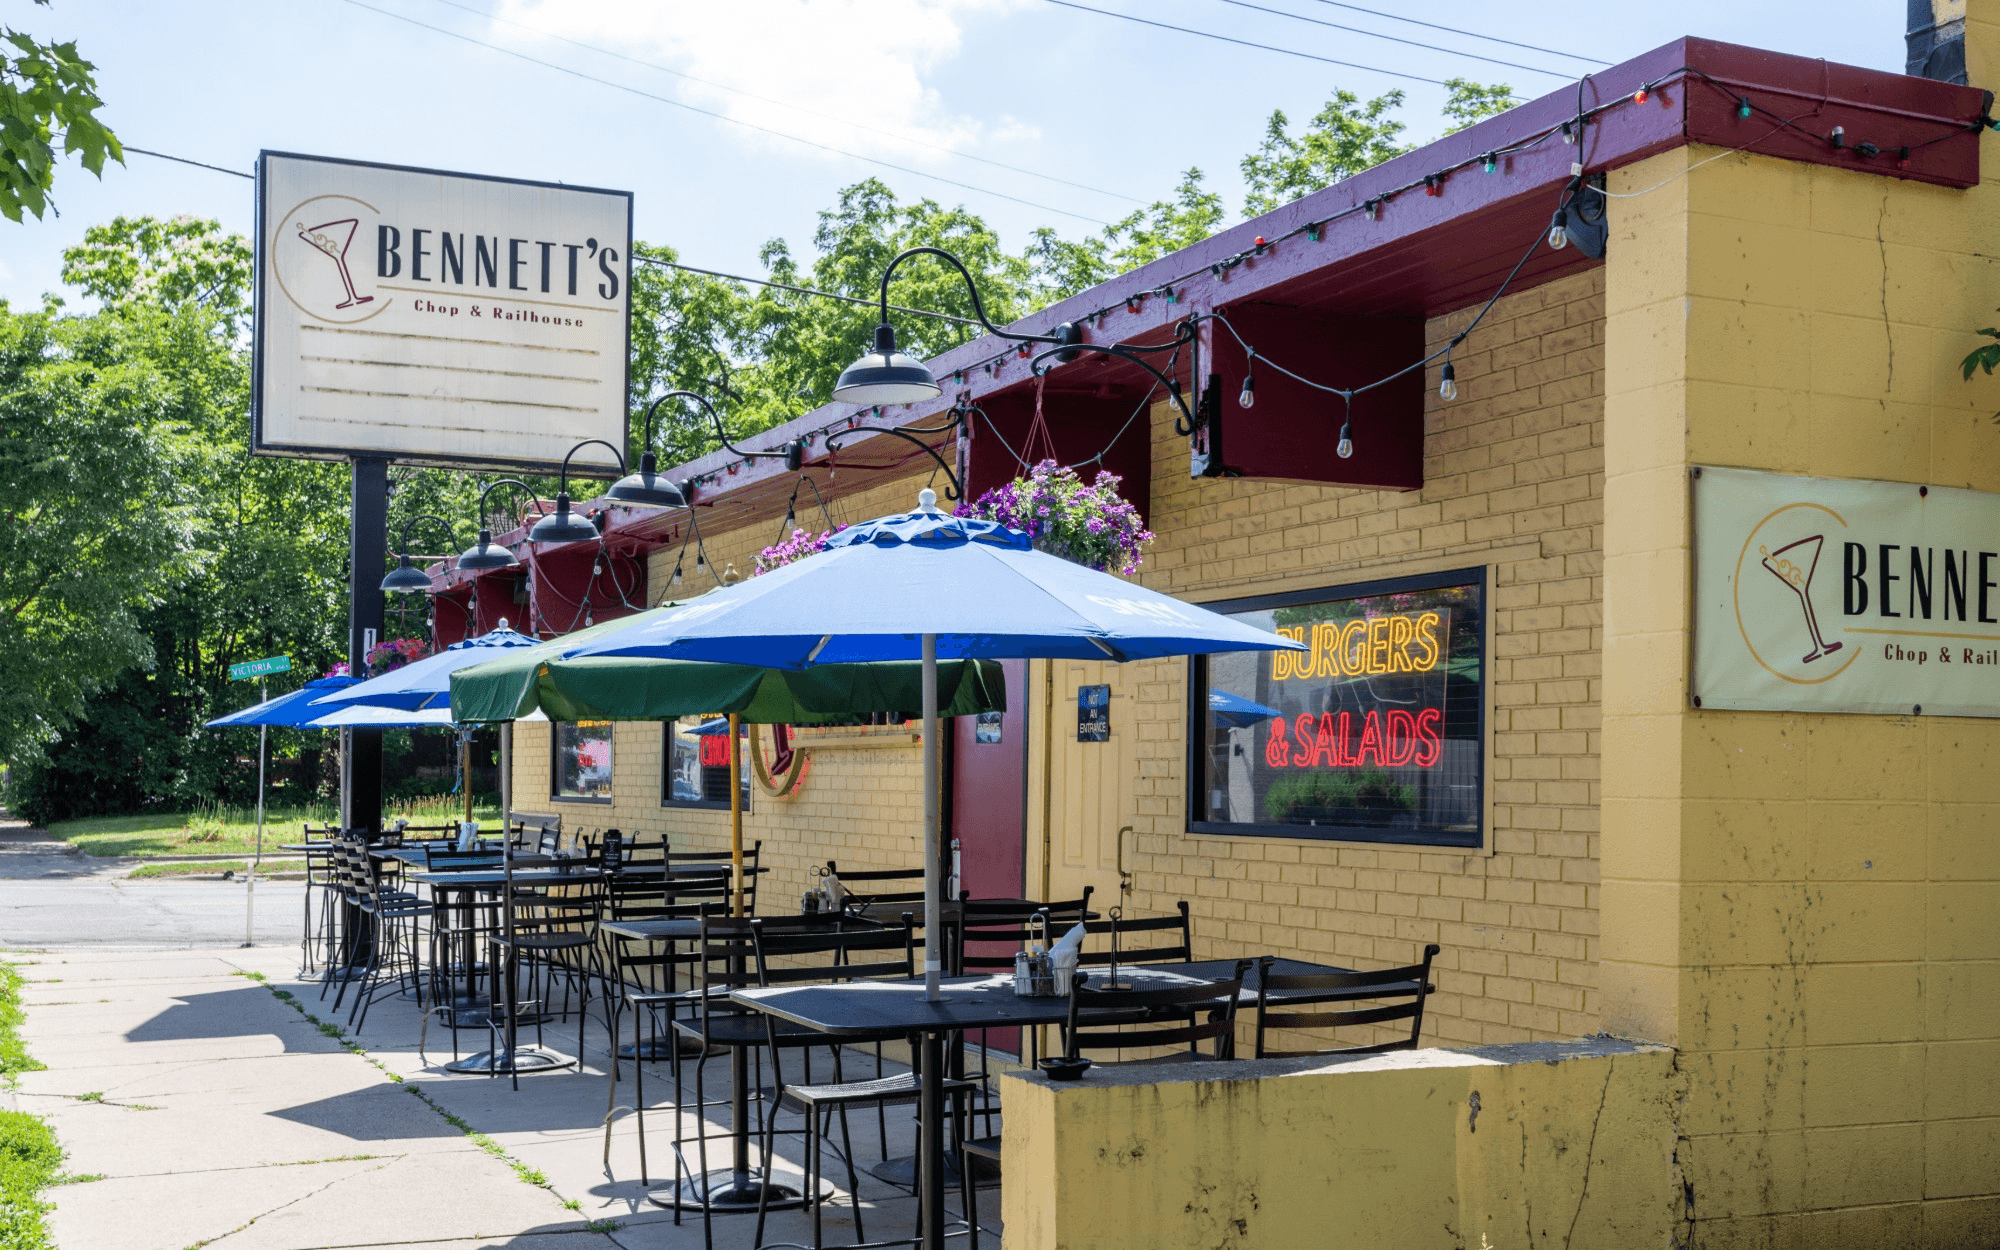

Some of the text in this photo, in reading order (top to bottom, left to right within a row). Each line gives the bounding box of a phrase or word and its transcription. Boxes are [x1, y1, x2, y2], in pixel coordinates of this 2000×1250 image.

[378, 224, 619, 300] BENNETT'S
[414, 299, 584, 328] Chop & Railhouse
[1273, 612, 1439, 681] BURGERS
[1884, 643, 1927, 665] Chop
[1939, 647, 1951, 663] &
[231, 662, 272, 676] VICTORIA
[1088, 694, 1099, 705] NOT
[1089, 708, 1098, 719] AN
[1080, 722, 1106, 733] ENTRANCE
[1265, 708, 1440, 768] & SALADS
